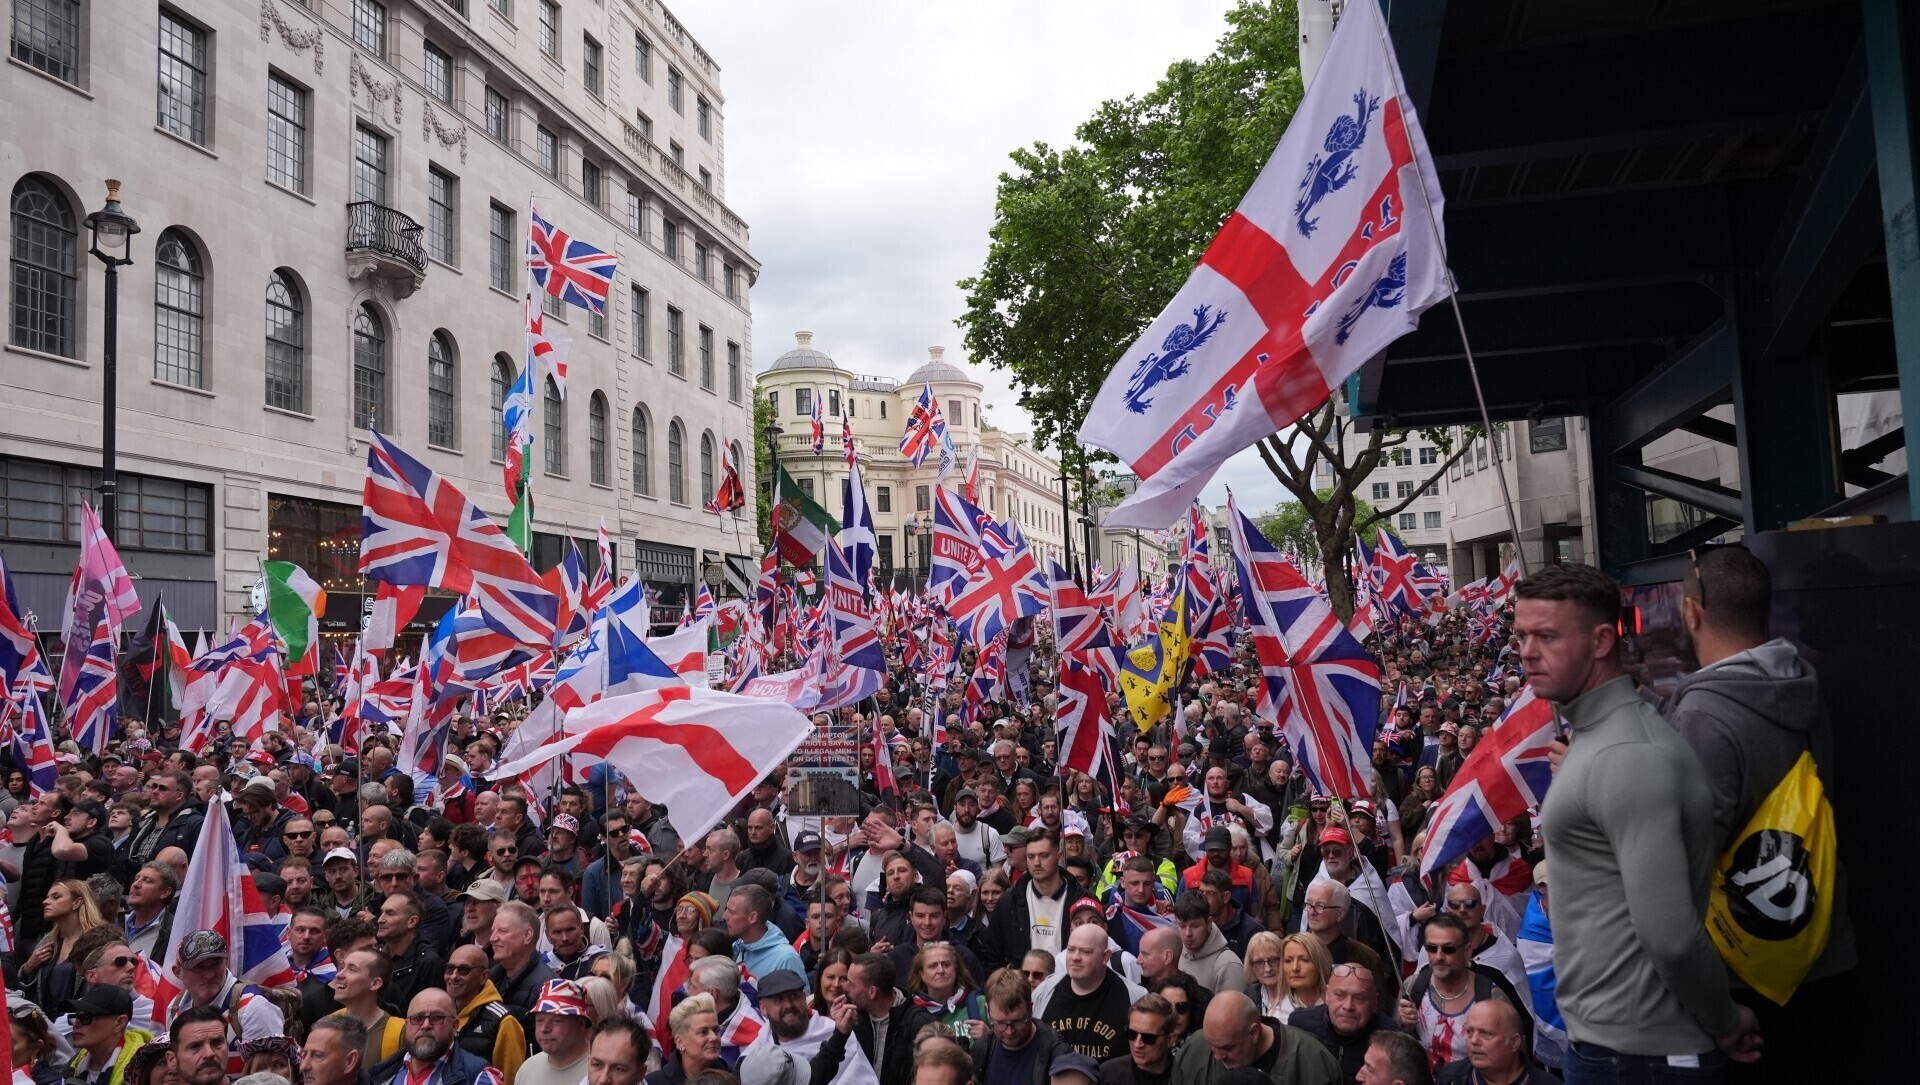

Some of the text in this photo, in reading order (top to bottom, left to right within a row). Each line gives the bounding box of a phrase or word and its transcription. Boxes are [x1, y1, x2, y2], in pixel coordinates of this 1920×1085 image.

[941, 537, 969, 562] UNITE
[1051, 1016, 1116, 1040] EAR OF GOD
[1070, 1044, 1110, 1058] NTIALS
